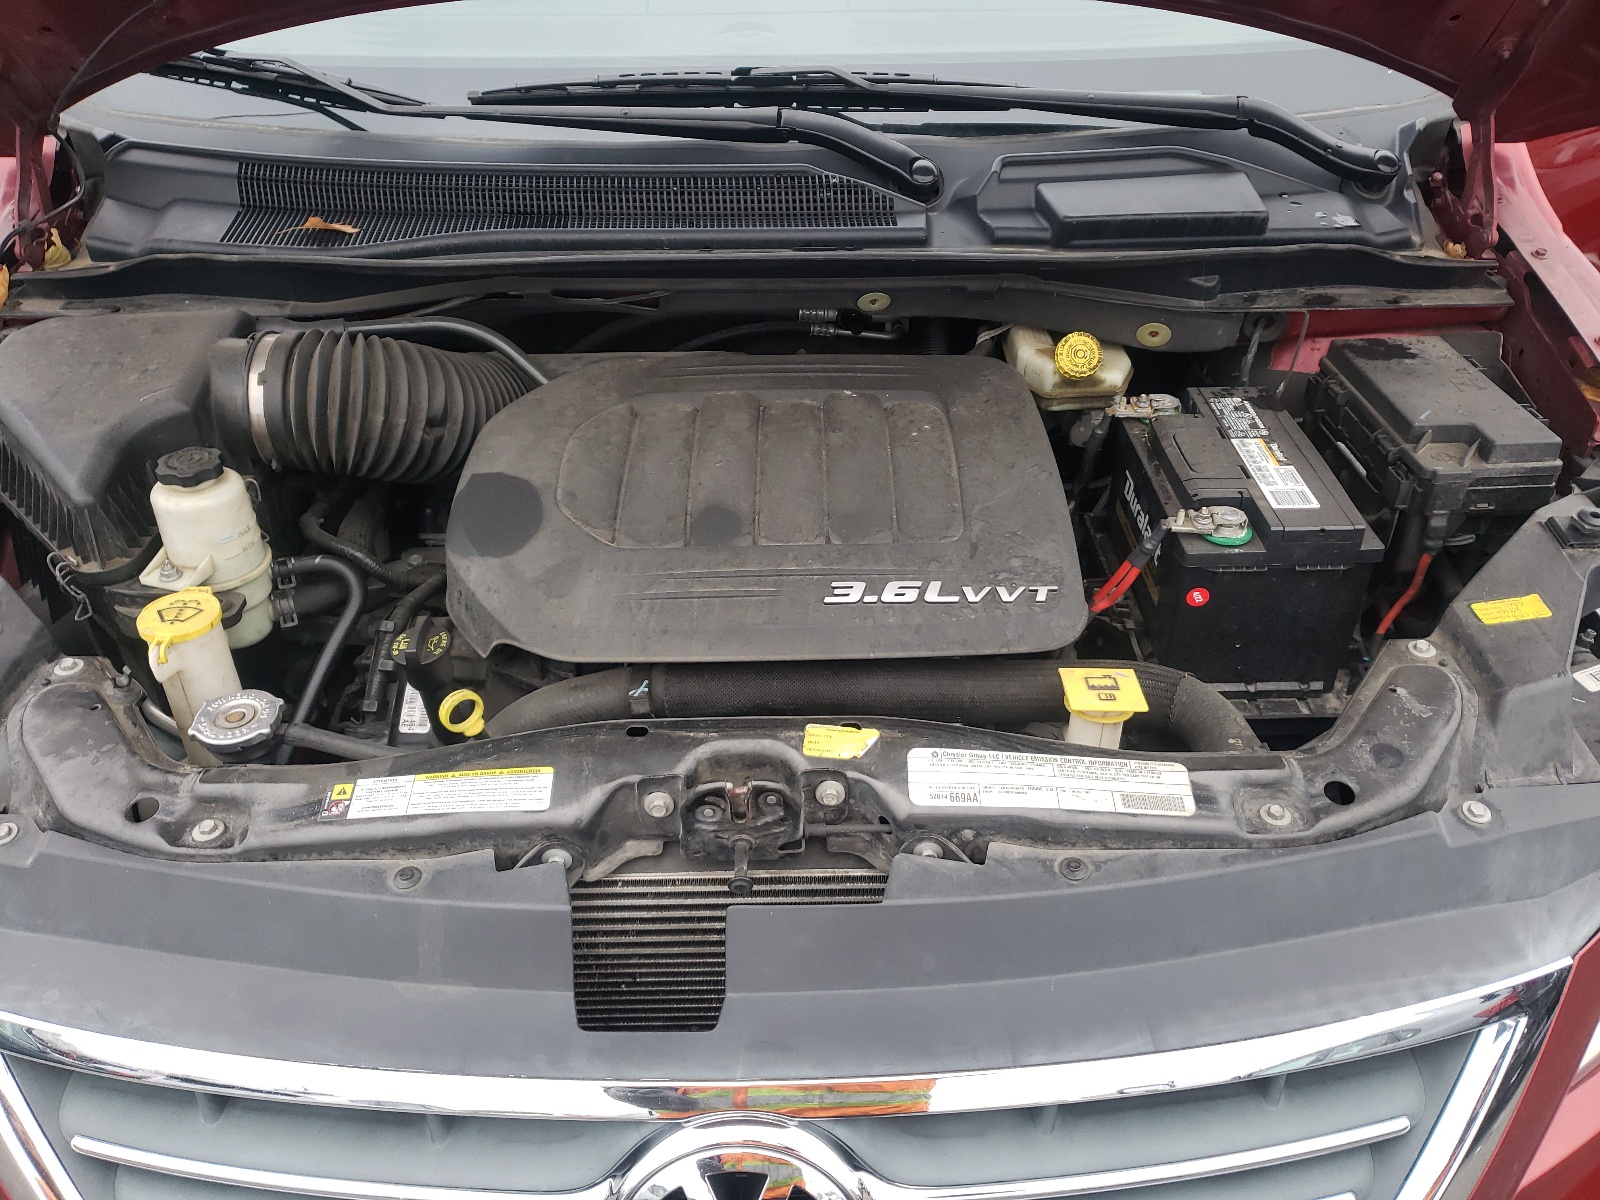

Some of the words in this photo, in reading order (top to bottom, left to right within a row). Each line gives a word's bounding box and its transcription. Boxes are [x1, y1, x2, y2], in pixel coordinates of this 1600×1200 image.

[1123, 469, 1162, 568] Duralat
[942, 750, 967, 758] Chrysler
[968, 752, 987, 760] Group
[1005, 753, 1029, 761] VEHICLE
[1030, 755, 1059, 763] EMISSION
[1059, 757, 1086, 765] CONTROL
[1088, 759, 1129, 768] INFORMATION
[949, 792, 979, 803] 669AA
